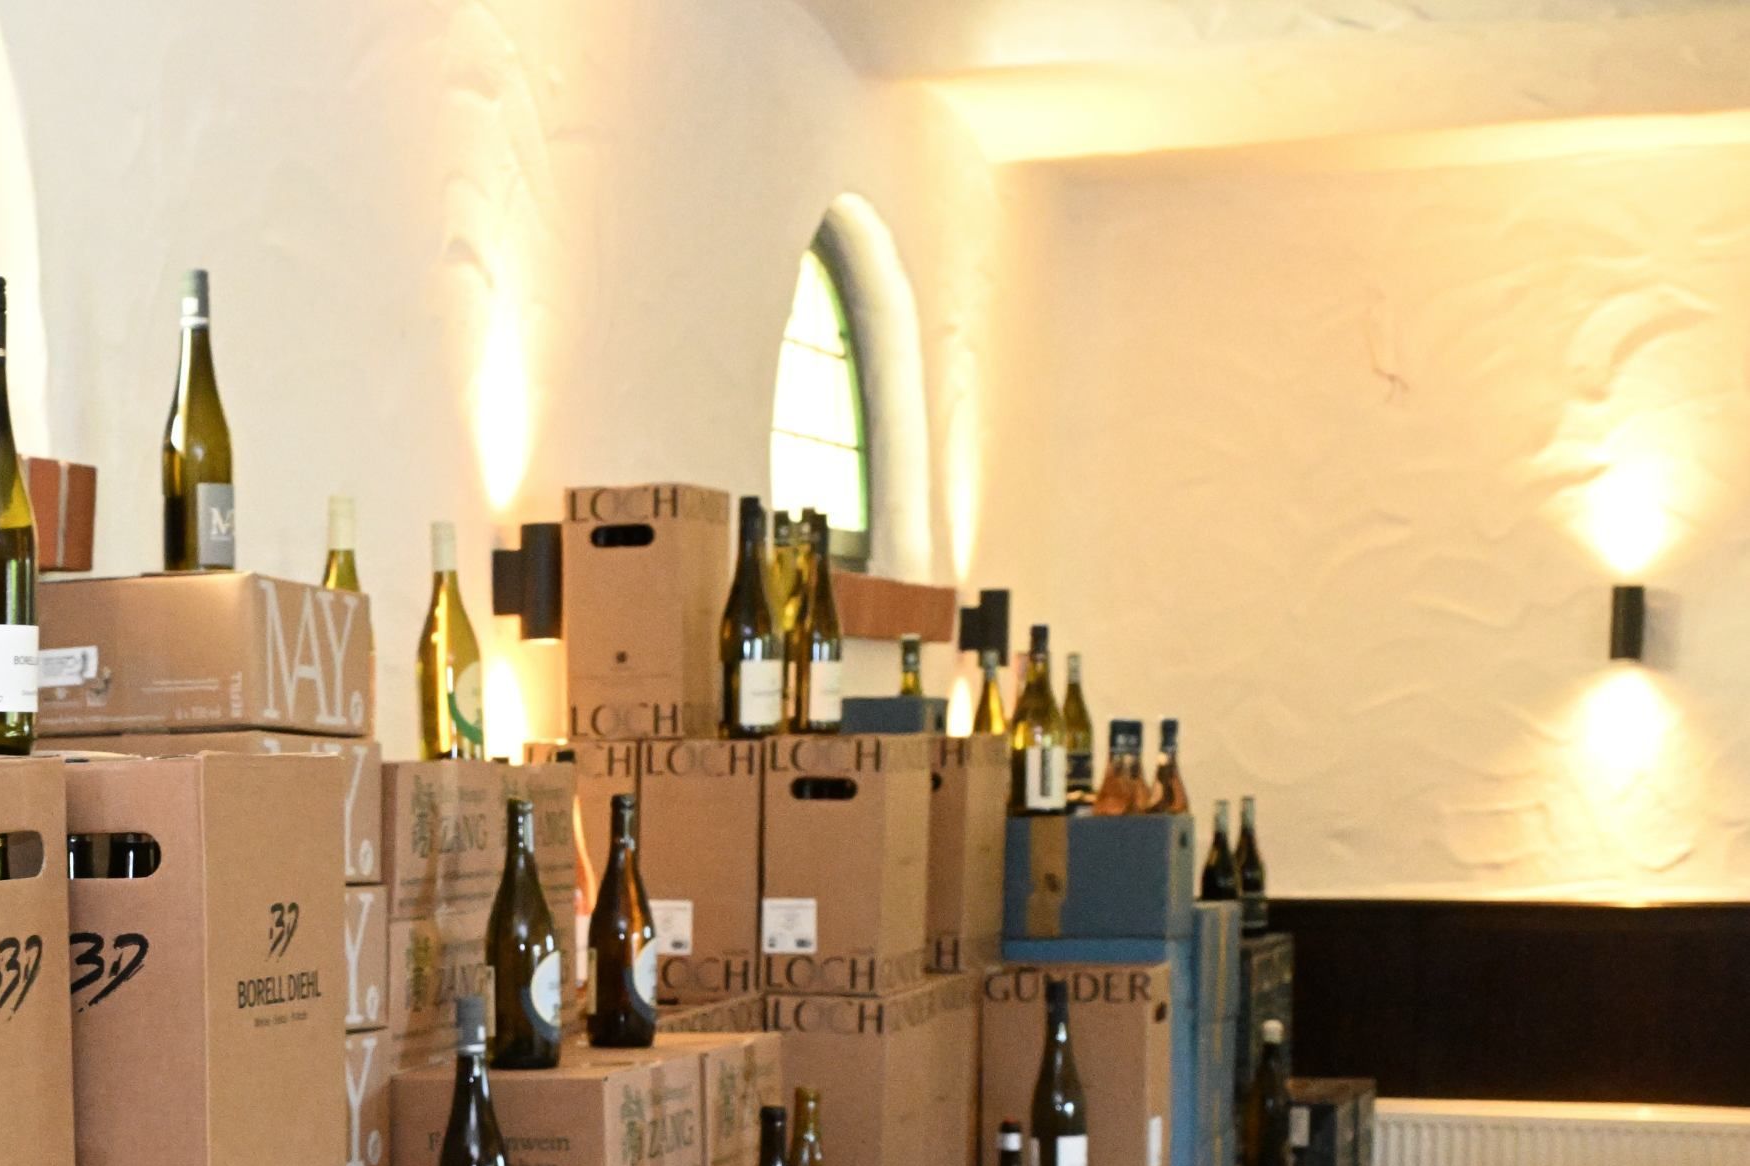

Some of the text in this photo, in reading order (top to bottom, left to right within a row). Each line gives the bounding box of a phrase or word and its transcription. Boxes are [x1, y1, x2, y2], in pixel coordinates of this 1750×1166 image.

[571, 486, 678, 522] LOCH
[571, 702, 678, 738] LOCH
[646, 743, 755, 777] LOCH
[770, 737, 883, 774] LOCH
[238, 970, 323, 1010] BORELL DIEHL
[765, 954, 877, 992] LOCH
